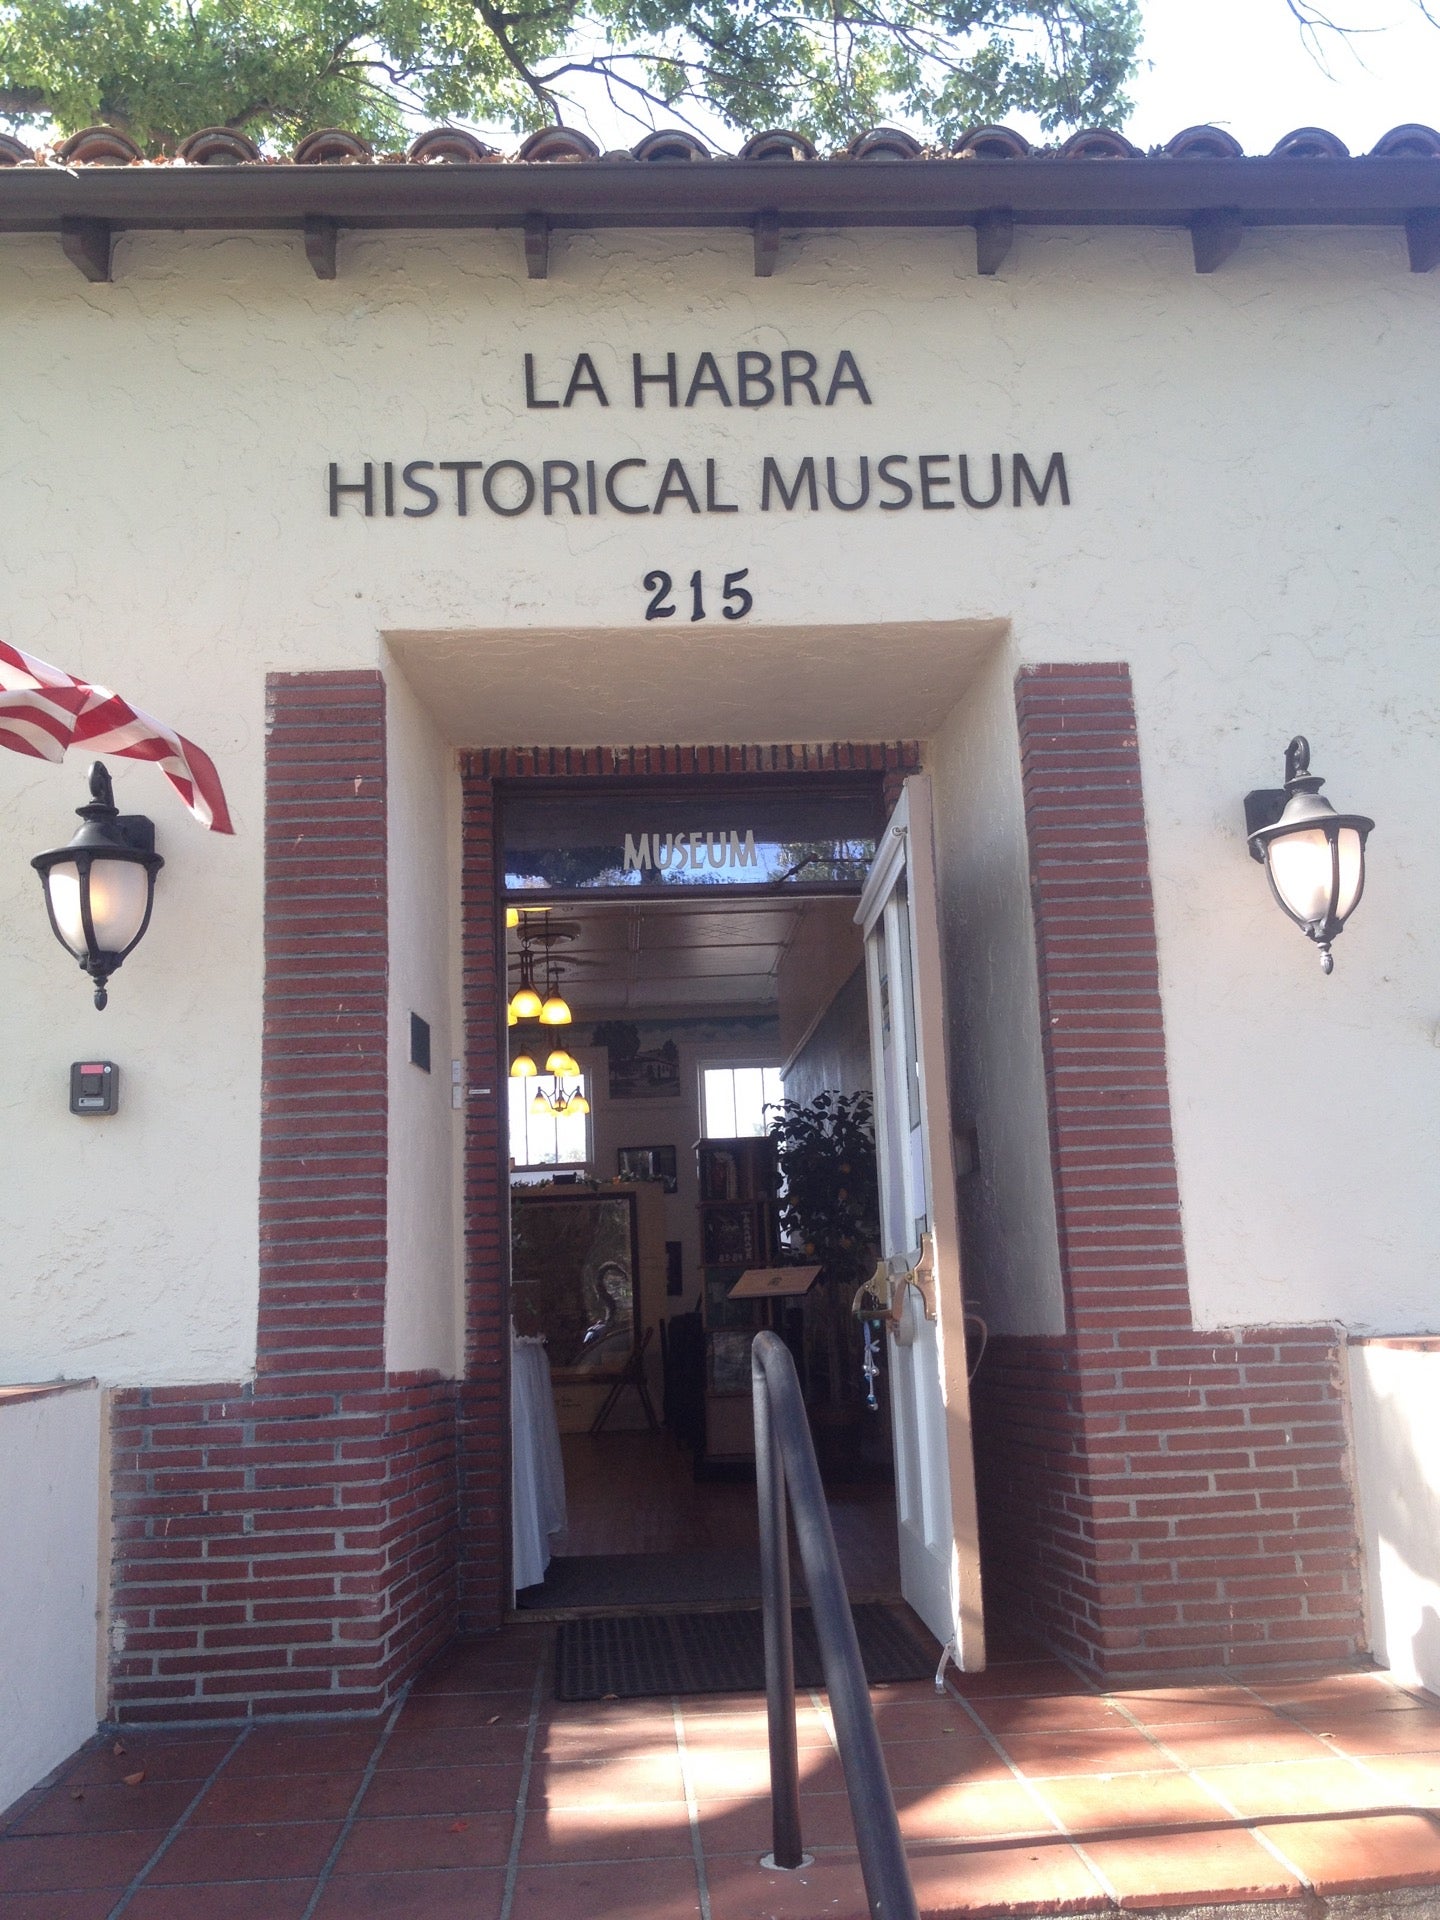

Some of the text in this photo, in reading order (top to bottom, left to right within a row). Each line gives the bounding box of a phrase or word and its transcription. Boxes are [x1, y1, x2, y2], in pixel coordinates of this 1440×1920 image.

[524, 349, 873, 409] LA HABRA
[328, 451, 1071, 518] HISTORICAL MUSEUM
[643, 567, 754, 622] 215
[623, 829, 758, 871] MUSEUM
